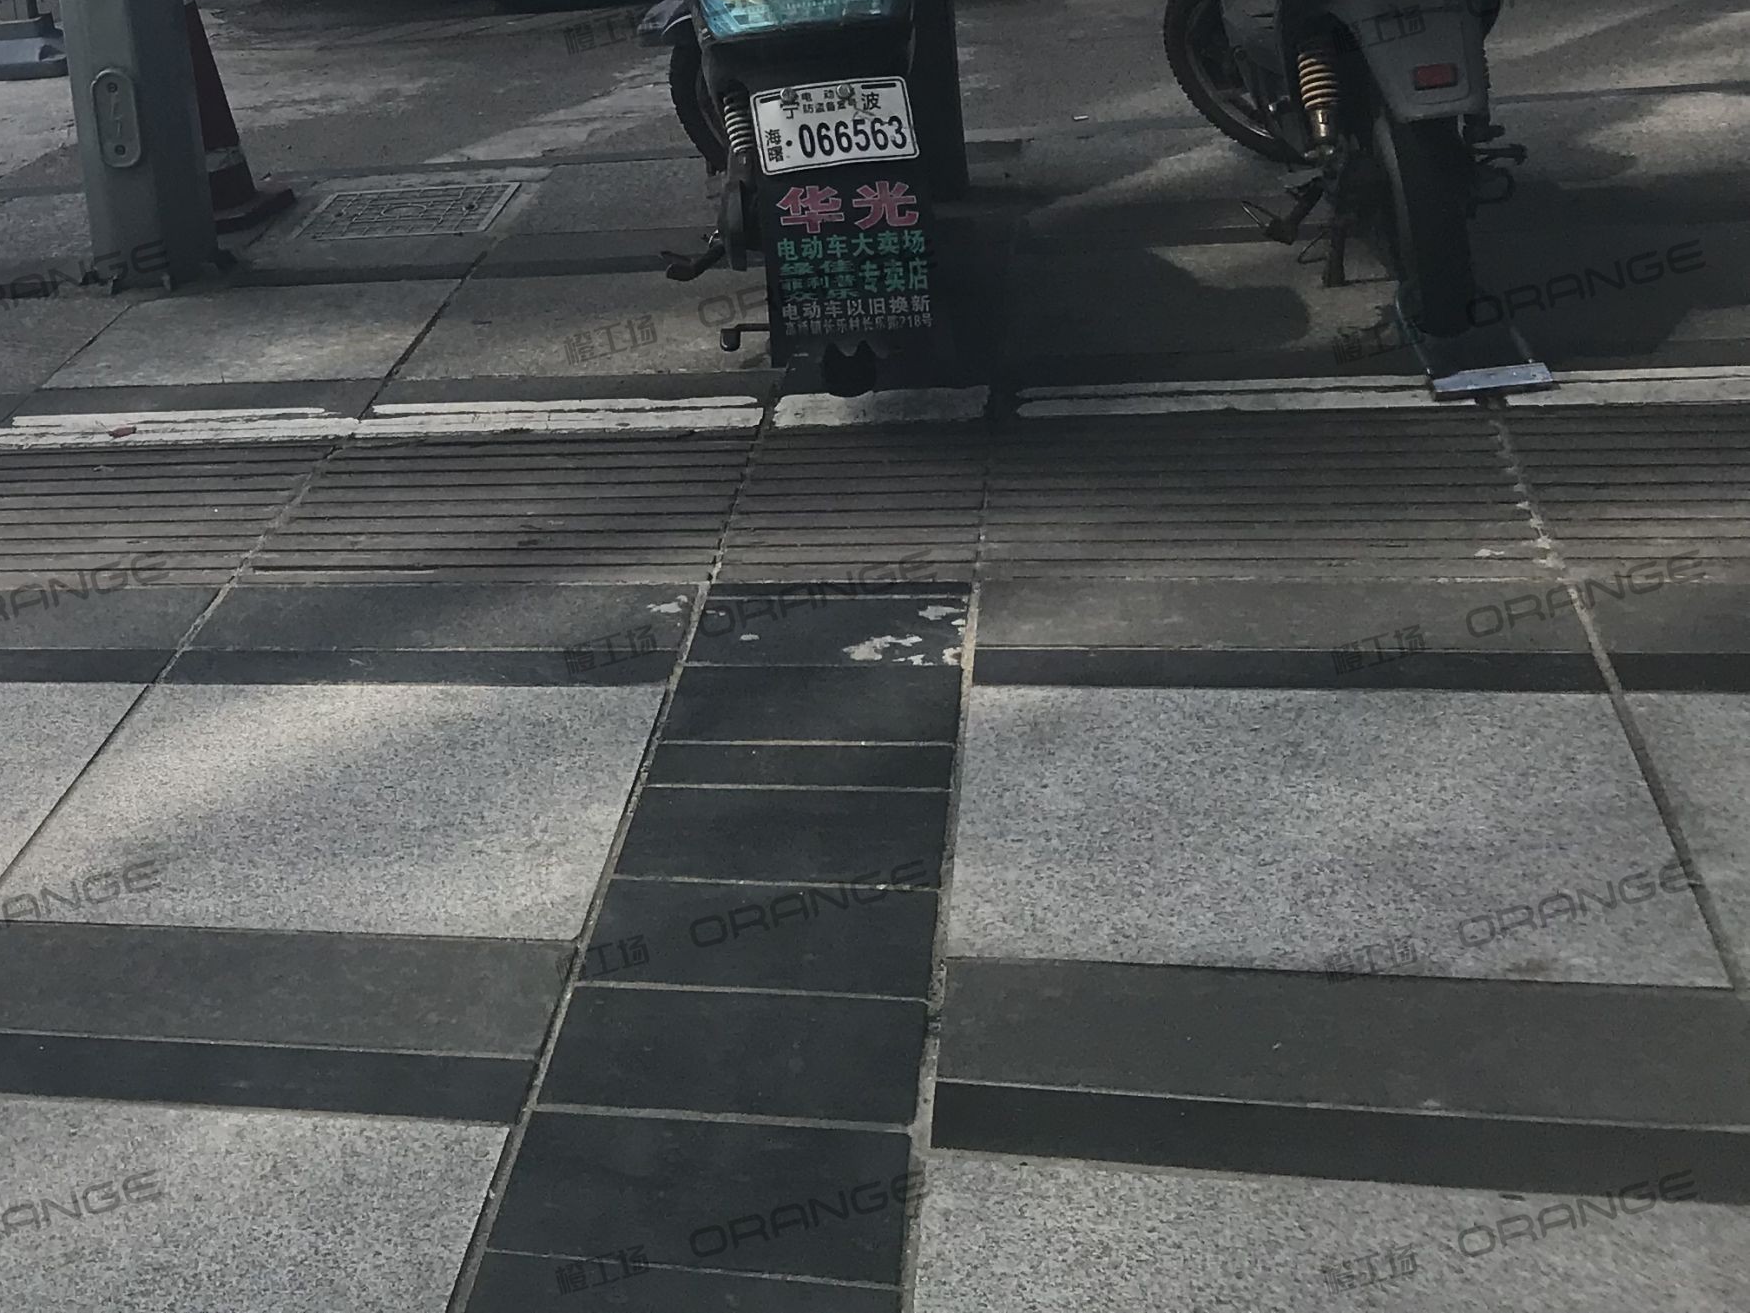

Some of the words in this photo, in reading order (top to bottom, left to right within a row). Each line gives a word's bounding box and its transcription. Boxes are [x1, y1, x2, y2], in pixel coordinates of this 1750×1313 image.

[860, 92, 882, 111] 波
[797, 114, 908, 159] 066563
[776, 179, 921, 235] 华光
[776, 228, 928, 262] 电动车大卖场
[858, 256, 930, 294] 专卖店
[781, 294, 932, 322] 电动车以旧换新
